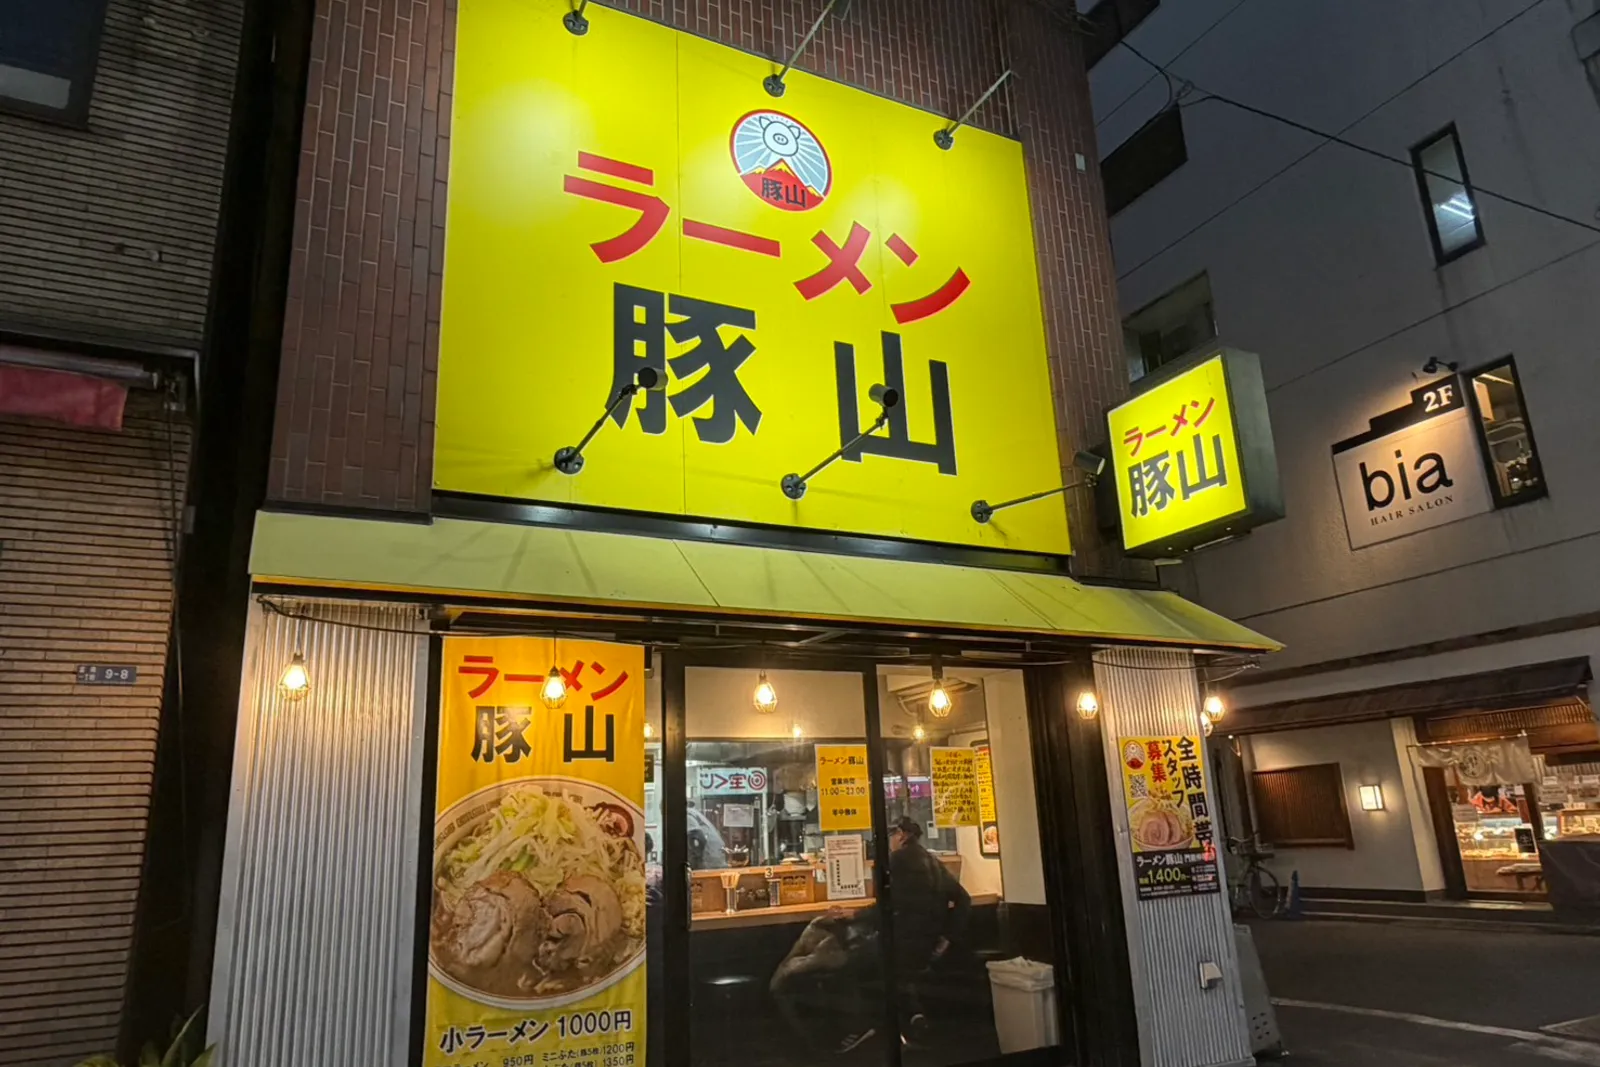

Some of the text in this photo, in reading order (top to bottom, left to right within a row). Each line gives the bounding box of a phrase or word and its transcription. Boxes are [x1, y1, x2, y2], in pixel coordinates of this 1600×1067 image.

[761, 176, 806, 208] 豚山
[564, 150, 971, 325] ラーメン
[604, 281, 959, 476] 豚山
[1423, 384, 1453, 412] 2F
[1123, 397, 1216, 458] ラーメン
[1127, 433, 1228, 519] 豚山
[1359, 449, 1454, 512] bia
[1370, 495, 1454, 526] HAIR SALON
[104, 668, 129, 680] 9-8
[457, 655, 629, 701] ラーメン
[471, 705, 615, 763] 豚山
[1144, 740, 1168, 783] 募集
[1162, 739, 1184, 808] スタッフ
[1176, 736, 1213, 850] 全時間帯
[765, 868, 772, 877] 3
[439, 1010, 632, 1053] 小ラーメン 1000円
